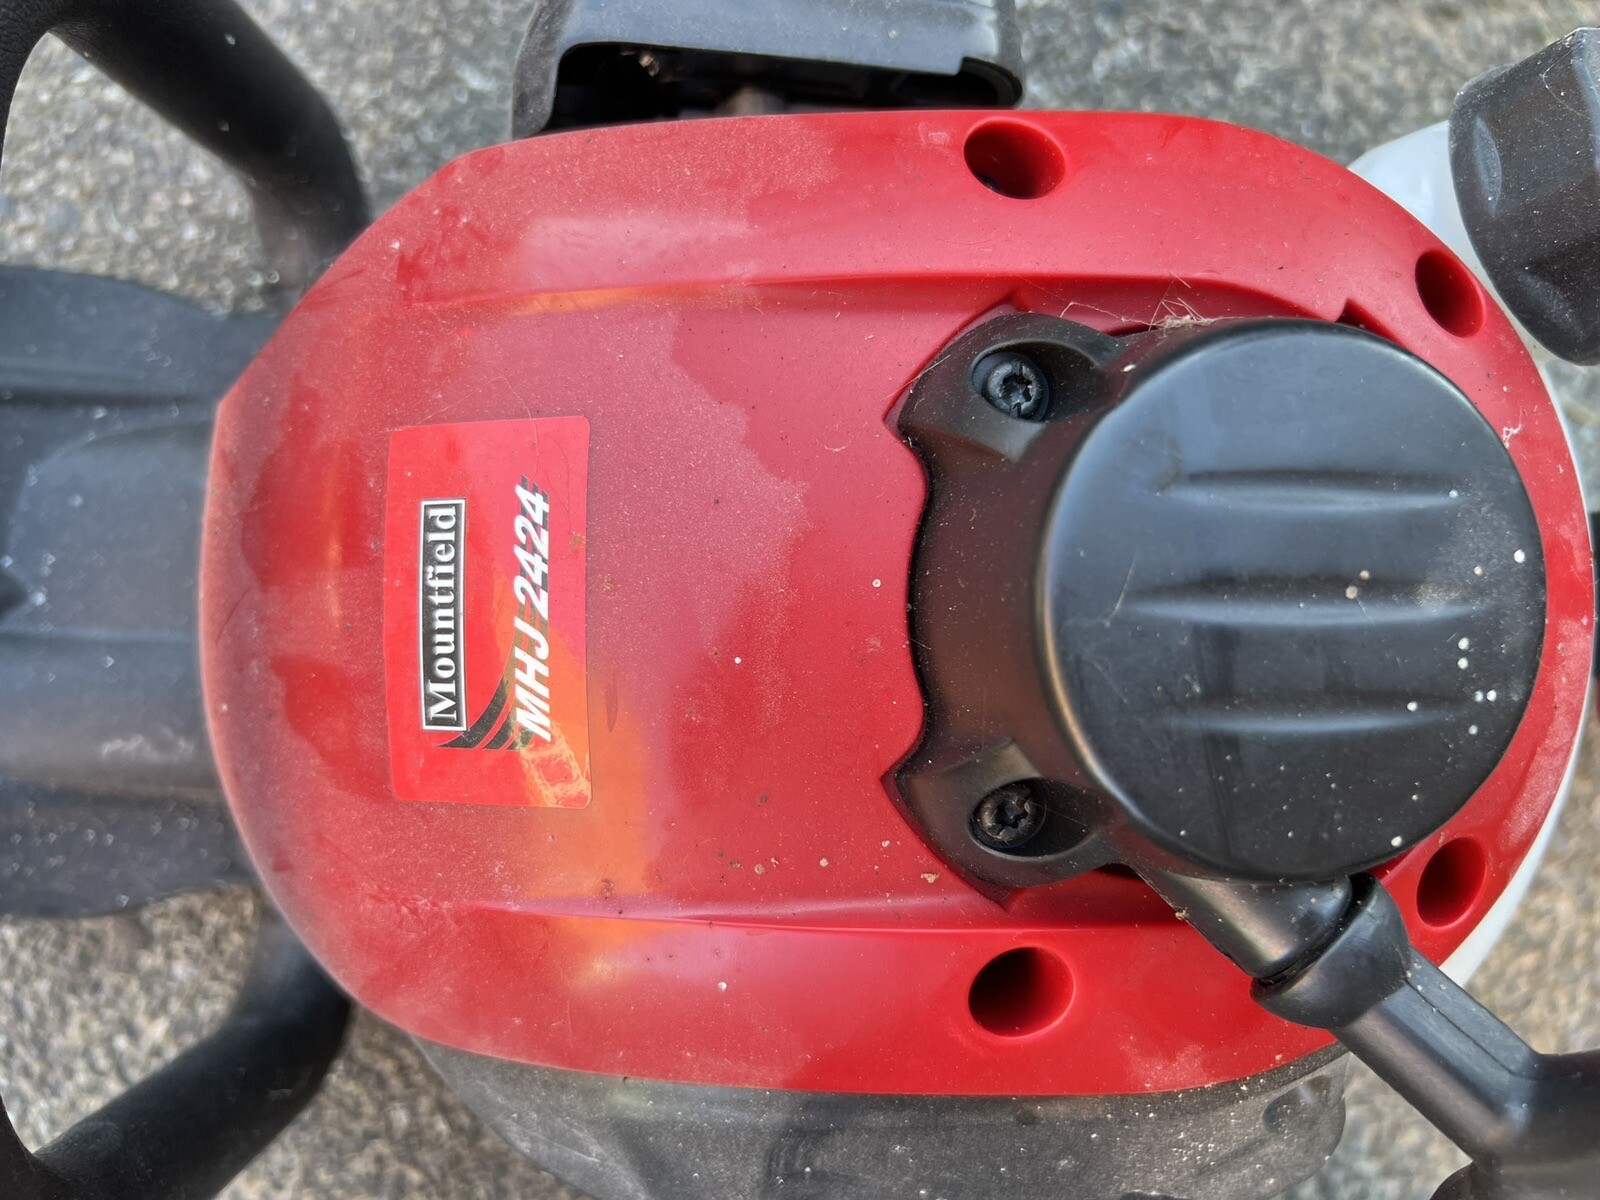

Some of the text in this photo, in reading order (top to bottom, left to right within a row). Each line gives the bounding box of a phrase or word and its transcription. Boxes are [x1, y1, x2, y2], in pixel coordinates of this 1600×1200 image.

[427, 504, 457, 722] Mountfield
[513, 484, 551, 741] MHJ 2424
